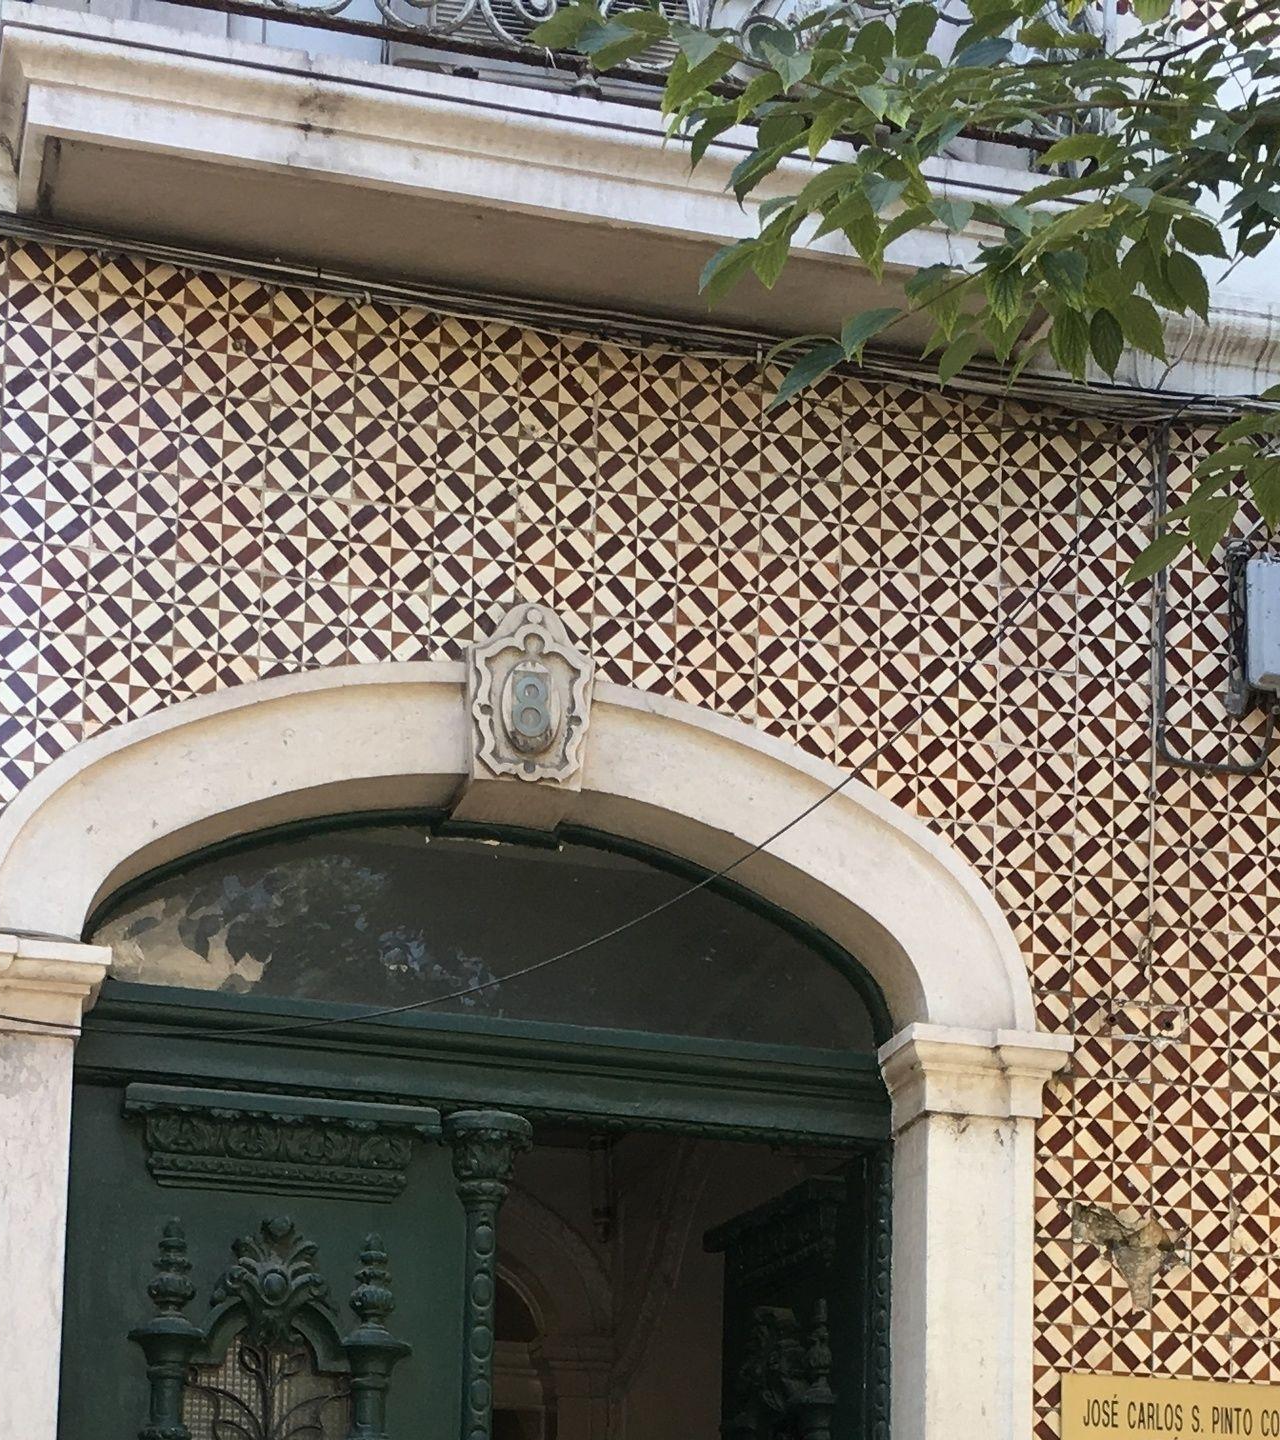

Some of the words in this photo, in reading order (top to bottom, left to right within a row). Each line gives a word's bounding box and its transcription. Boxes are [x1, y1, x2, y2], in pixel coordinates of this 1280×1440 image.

[512, 676, 549, 737] 8
[1083, 1394, 1119, 1428] JOSÉ
[1127, 1401, 1183, 1432] CARLOS
[1191, 1405, 1203, 1433] S.
[1212, 1406, 1253, 1436] PINTO
